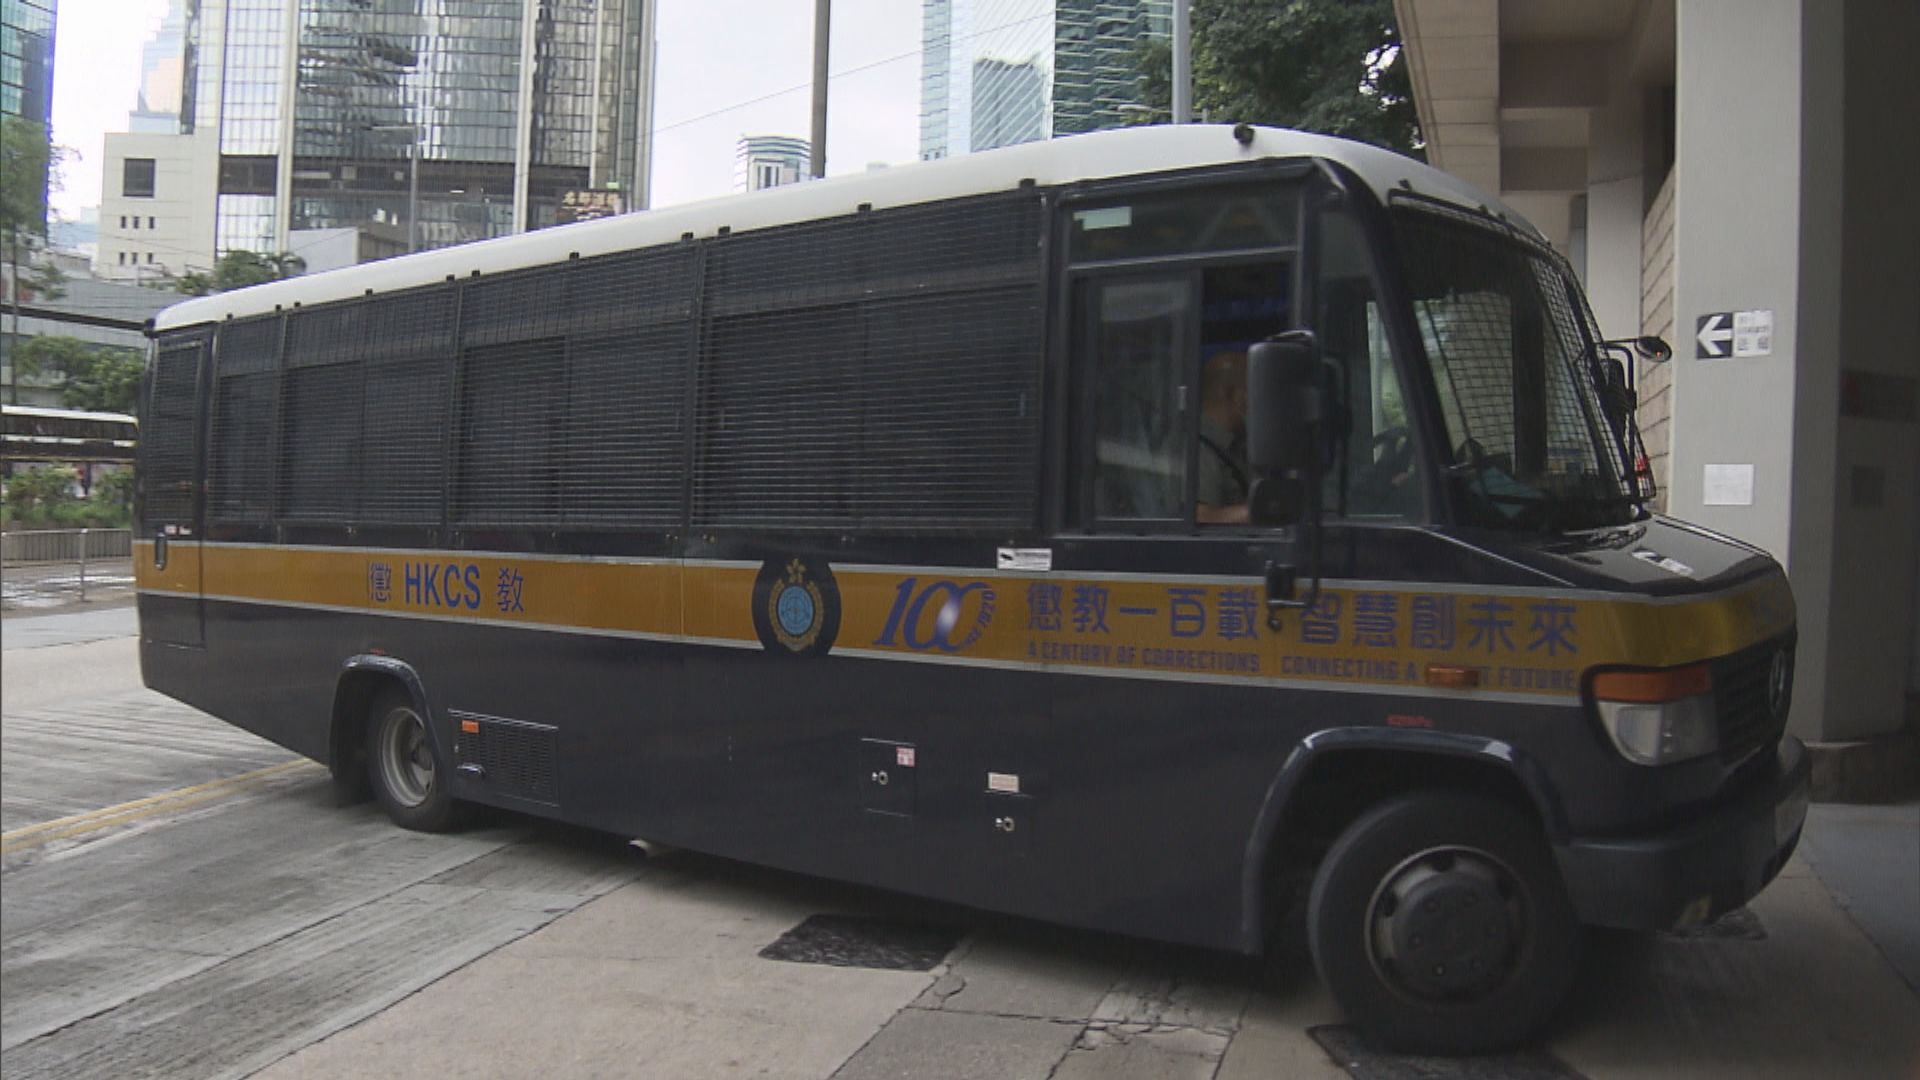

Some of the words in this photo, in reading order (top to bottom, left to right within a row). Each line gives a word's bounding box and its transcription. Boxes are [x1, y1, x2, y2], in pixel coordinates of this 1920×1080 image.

[405, 562, 481, 610] HKCS
[872, 576, 993, 653] 100
[1041, 642, 1112, 665] CENTURY
[1117, 645, 1137, 664] OF
[1141, 647, 1261, 673] CORRECTIONS
[1281, 655, 1399, 681] CONNECTING
[1498, 667, 1577, 690] FUTURE
